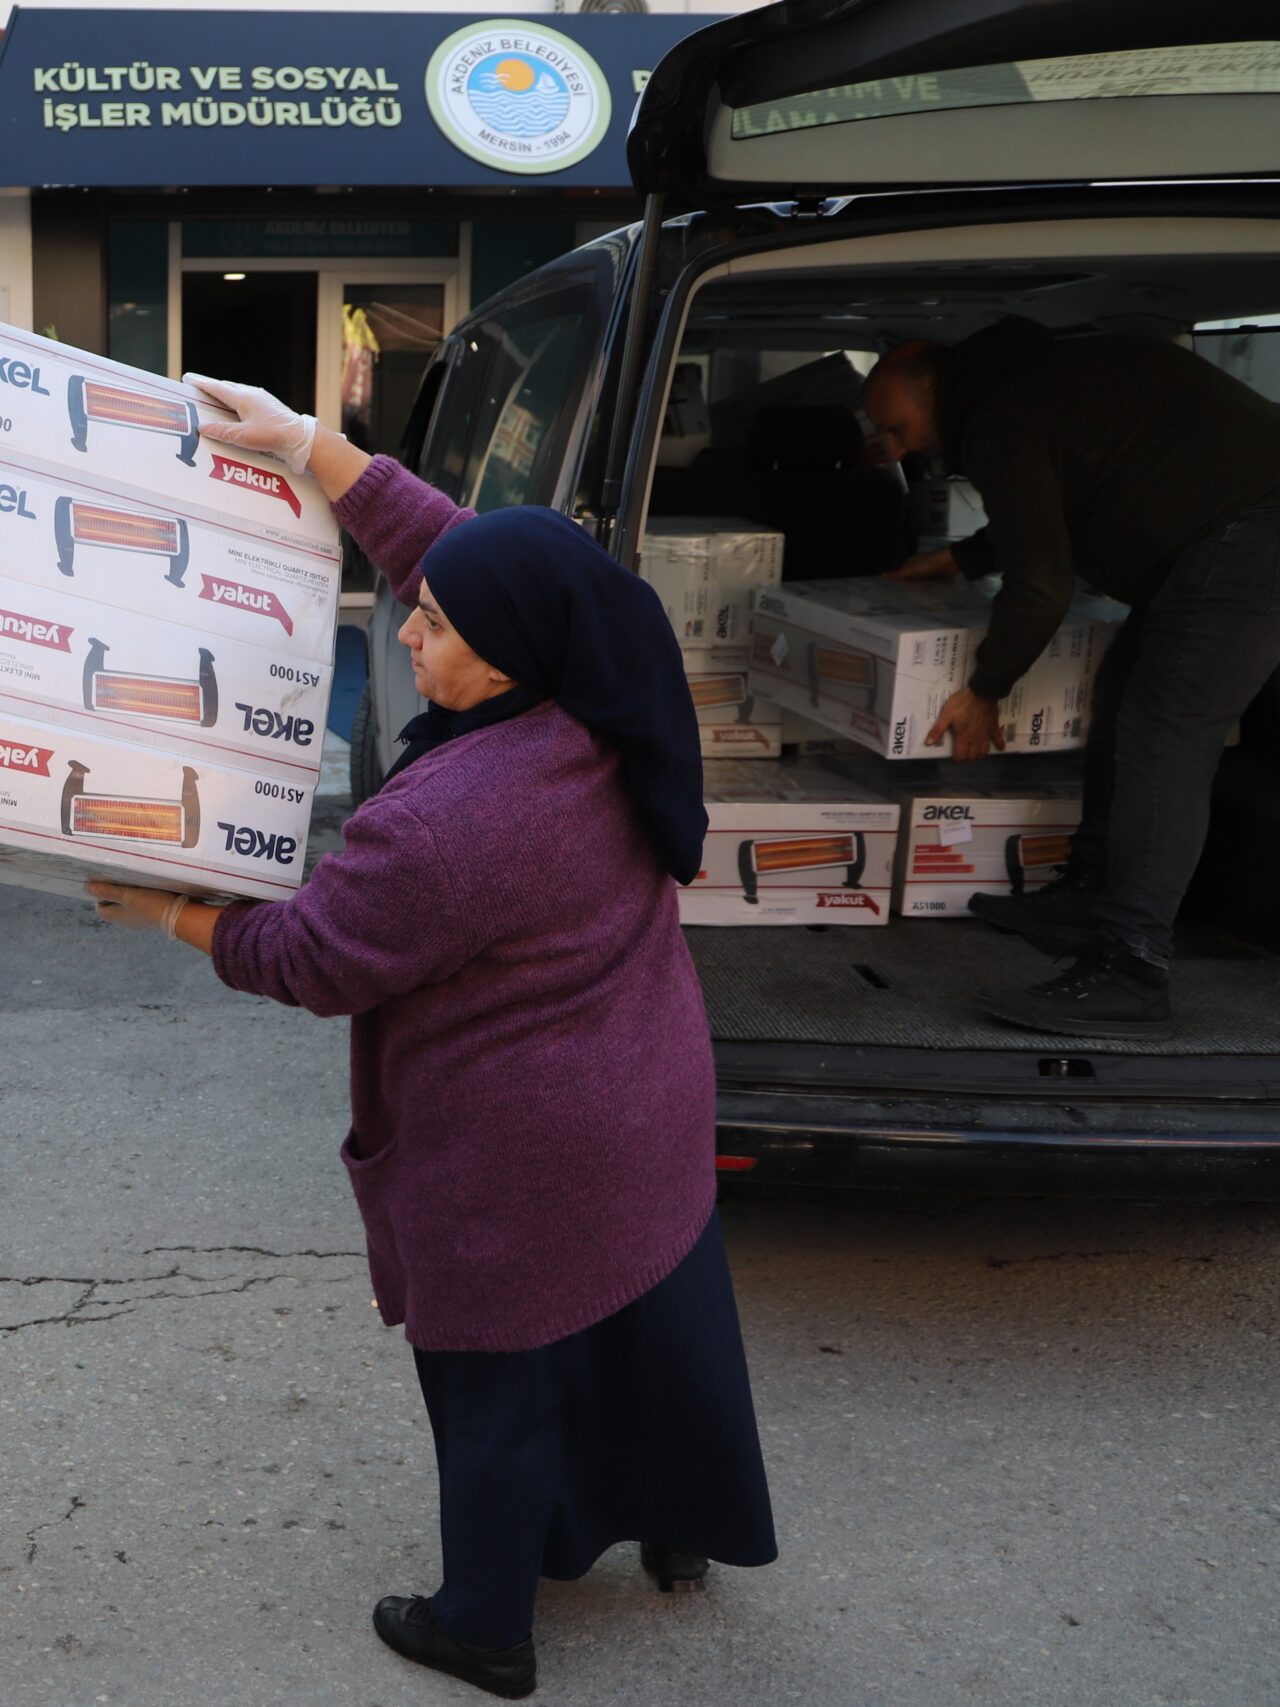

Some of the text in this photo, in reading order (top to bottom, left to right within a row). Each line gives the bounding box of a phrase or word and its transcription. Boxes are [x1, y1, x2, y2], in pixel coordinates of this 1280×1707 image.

[34, 62, 400, 91] KÜLTÜR VE SOSYAL
[451, 38, 497, 95] AKDENİZ
[500, 38, 586, 97] BELEDİYESİ
[44, 97, 402, 132] İŞLER MÜDÜRLÜĞÜ
[478, 128, 533, 153] MERSİN
[544, 130, 572, 151] 1994
[222, 463, 281, 493] yakut
[282, 564, 308, 577] QUARTZ
[211, 582, 272, 612] yakut
[270, 664, 320, 687] AS1000
[255, 781, 304, 804] AS1000
[823, 893, 866, 907] yakut
[912, 900, 947, 911] AS1000
